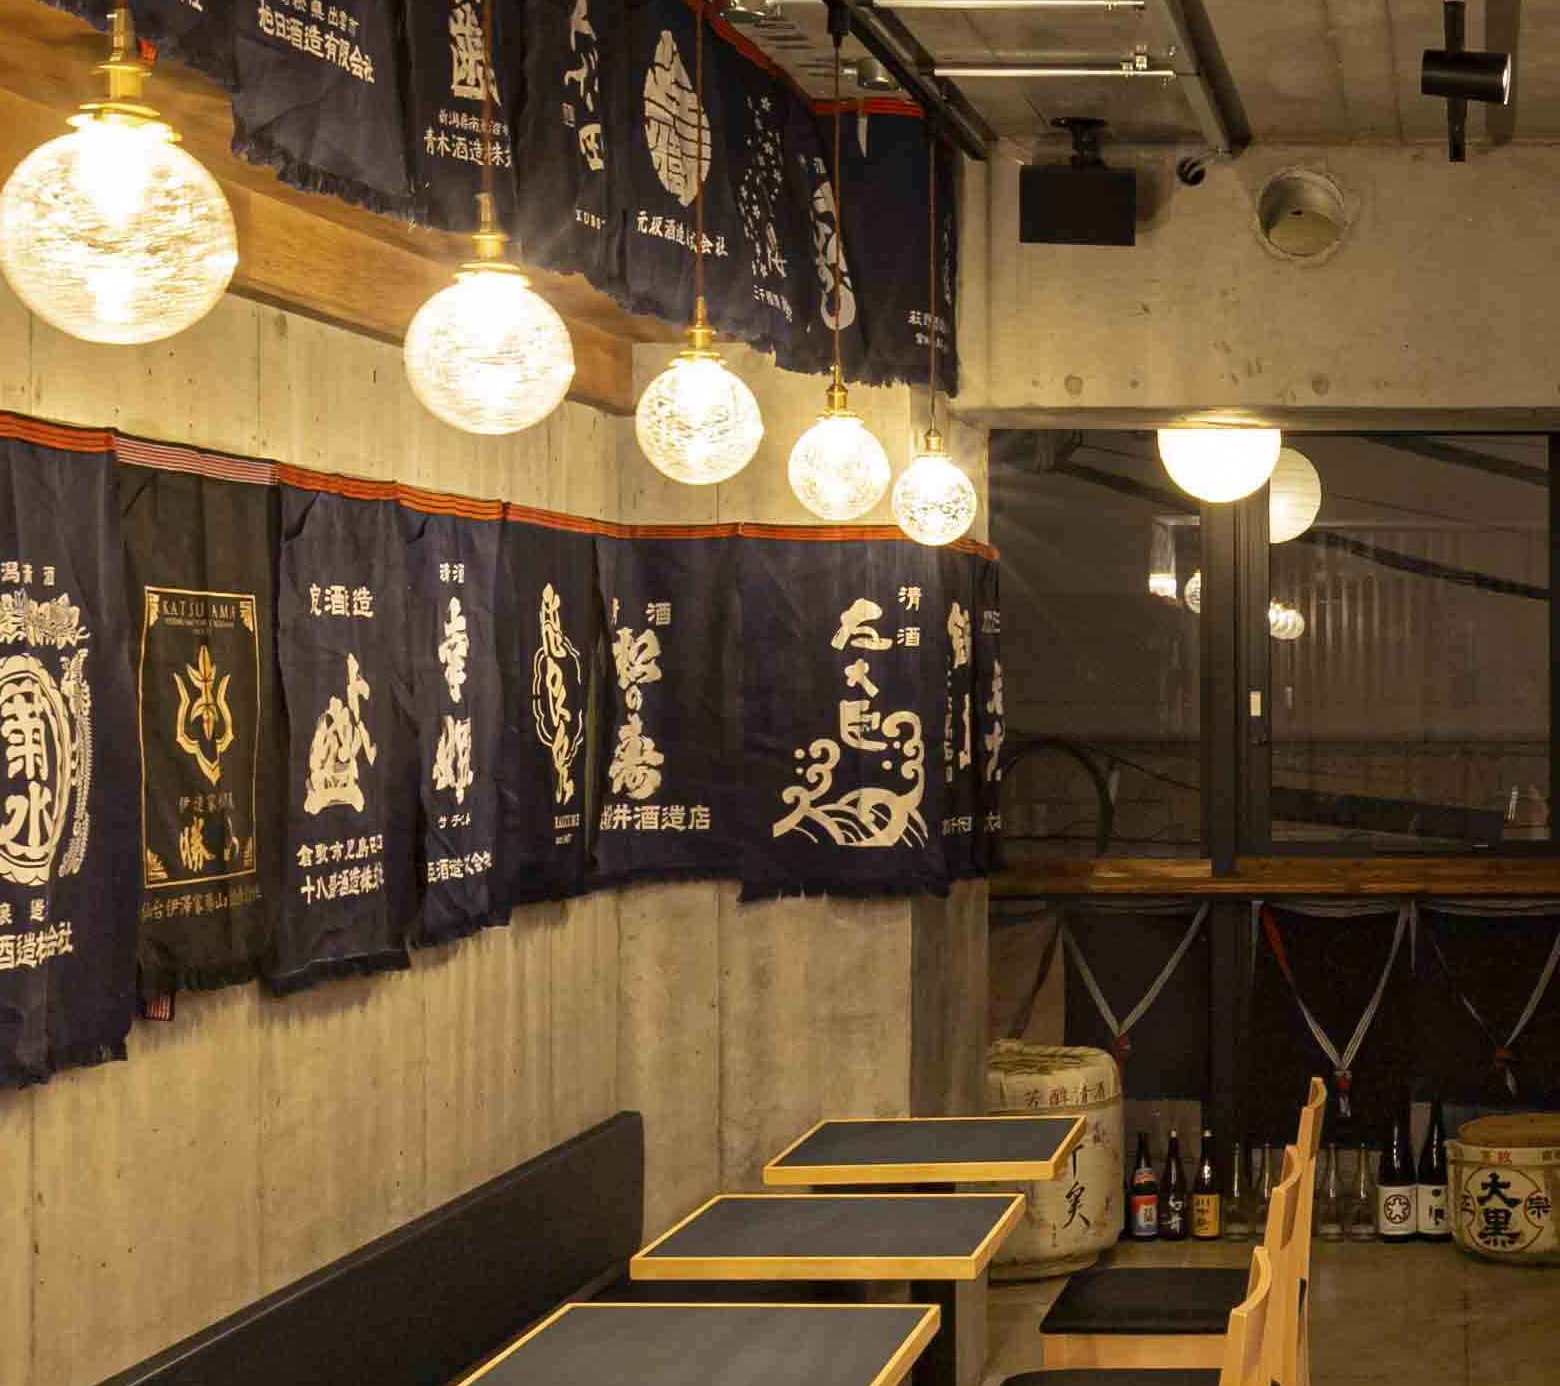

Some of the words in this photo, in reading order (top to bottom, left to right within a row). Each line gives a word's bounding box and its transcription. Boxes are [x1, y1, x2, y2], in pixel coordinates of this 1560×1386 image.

[897, 586, 922, 647] 清酒
[0, 687, 52, 857] 菊水
[1478, 1172, 1522, 1246] 大黒
